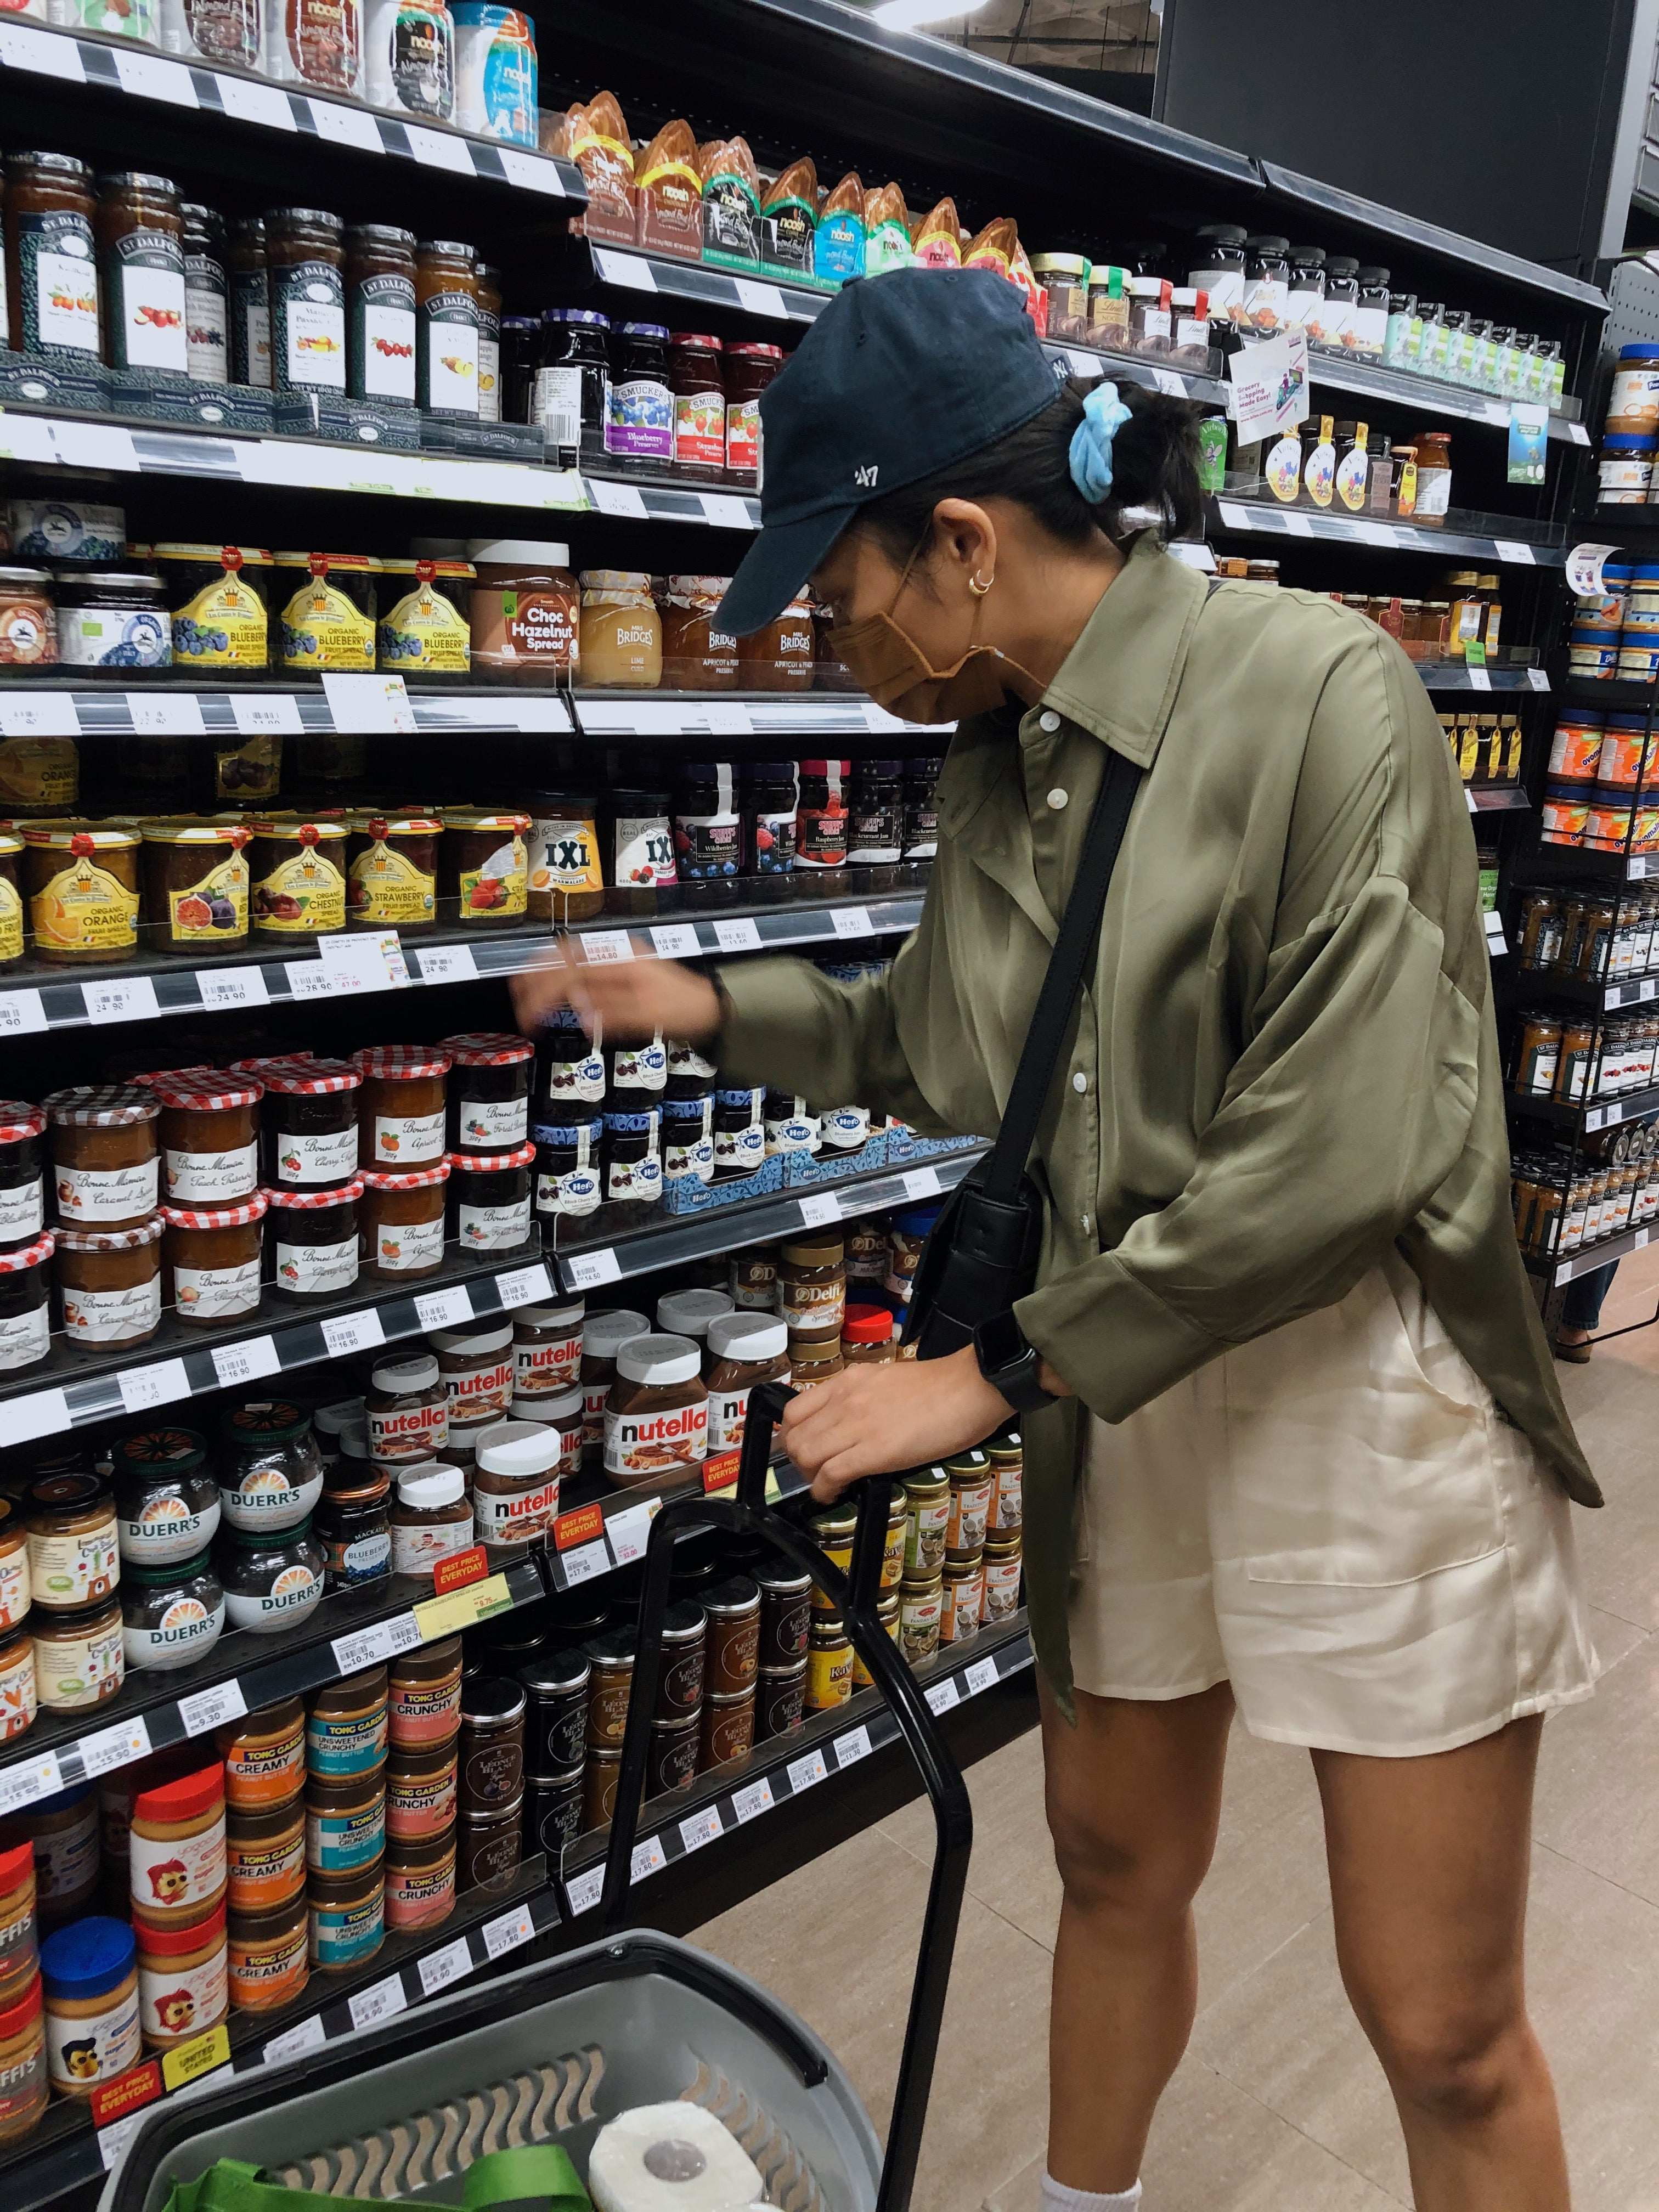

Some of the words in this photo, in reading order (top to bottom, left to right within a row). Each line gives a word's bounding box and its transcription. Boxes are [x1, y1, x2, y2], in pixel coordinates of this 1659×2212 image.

[662, 185, 689, 202] noosh
[780, 216, 805, 233] noosh
[831, 229, 855, 242] noosh
[1102, 300, 1125, 313] Lindt
[1237, 382, 1260, 393] Grocery
[1239, 399, 1255, 409] Made
[1256, 392, 1271, 403] Easy!
[627, 432, 663, 444] Blueberry
[527, 607, 564, 623] Choc
[511, 623, 573, 639] Hazelnut
[617, 628, 653, 646] BRIDGES
[319, 635, 366, 646] BLUEBERRY
[424, 639, 465, 649] BLUEBERRY
[527, 637, 565, 651] Spread
[780, 634, 811, 652] BRIDGES
[703, 658, 725, 667] APRICOT
[545, 840, 591, 870] IXL
[704, 845, 729, 854] Wildberries
[552, 877, 585, 885] MARMALADE
[316, 890, 341, 900] ORGANIC
[375, 891, 425, 902] STRAWBERRY
[91, 905, 124, 916] ORGANIC
[83, 912, 129, 927] ORANGE
[649, 1054, 664, 1065] Hero
[587, 1066, 603, 1077] Hero
[487, 1105, 513, 1119] Bonne
[403, 1120, 430, 1135] Bonne
[494, 1122, 513, 1134] Forest
[839, 1117, 860, 1127] Hero
[788, 1128, 809, 1137] Hero
[304, 1137, 334, 1153] Bonne
[411, 1137, 439, 1151] Apricot
[747, 1136, 761, 1146] Hero
[699, 1150, 713, 1159] Hero
[899, 1143, 915, 1154] Hero
[177, 1155, 207, 1171] Bonne
[315, 1155, 340, 1167] Cherry
[644, 1168, 659, 1177] Hero
[803, 1167, 820, 1178] Hero
[77, 1172, 110, 1188] Bonne
[191, 1175, 219, 1187] Peach
[572, 1181, 594, 1191] Hero
[93, 1192, 131, 1205] Caramel
[692, 1192, 711, 1203] Hero
[483, 1209, 510, 1222] Bonne
[584, 1272, 601, 1281] 14.50
[510, 1291, 529, 1301] 16.90
[809, 1284, 840, 1302] Delfi
[429, 1313, 448, 1323] 16.90
[338, 1338, 359, 1348] 16.90
[518, 1340, 583, 1368] nutella
[229, 1367, 250, 1378] 16.90
[445, 1364, 513, 1396] nutella
[371, 1408, 445, 1435] nutella
[622, 1408, 708, 1442] nutella
[709, 1462, 723, 1473] BEST
[724, 1456, 740, 1469] PRICE
[231, 1489, 300, 1507] DUERR'S
[129, 1516, 200, 1537] DUERR'S
[561, 1518, 578, 1531] BEST
[578, 1511, 597, 1526] PRICE
[560, 1519, 599, 1541] EVERYDAY
[348, 1541, 388, 1560] BLUEBERRY
[623, 1548, 637, 1560] 32.00
[442, 1560, 460, 1574] BEST
[460, 1554, 480, 1567] PRICE
[440, 1561, 483, 1584] EVERYDAY
[261, 1579, 320, 1611] DUERR'S
[479, 1596, 493, 1607] 9.75
[150, 1615, 216, 1644] DUERR'S
[351, 1650, 374, 1664] 10.70
[408, 1692, 435, 1703] TONG
[397, 1698, 453, 1716] CRUNCHY
[199, 1712, 221, 1726] 9.30
[422, 1712, 445, 1722] BUTTER
[318, 1729, 375, 1744] UNSWEETENED
[329, 1725, 356, 1735] TONG
[319, 1742, 357, 1751] CRUNCHY
[247, 1749, 275, 1760] TONG
[236, 1755, 290, 1774] CREAMY
[799, 1773, 815, 1786] 17.80
[391, 1786, 414, 1797] TONG
[414, 1779, 449, 1794] GARDEN
[744, 1802, 762, 1815] 17.80
[693, 1831, 711, 1844] 17.80
[242, 1854, 270, 1865] TONG
[230, 1860, 285, 1878] CREAMY
[398, 1877, 450, 1900] CRUNCHY
[179, 2043, 216, 2068] UNITED
[99, 2078, 155, 2114] EVERYDAY
[101, 2084, 123, 2102] BEST
